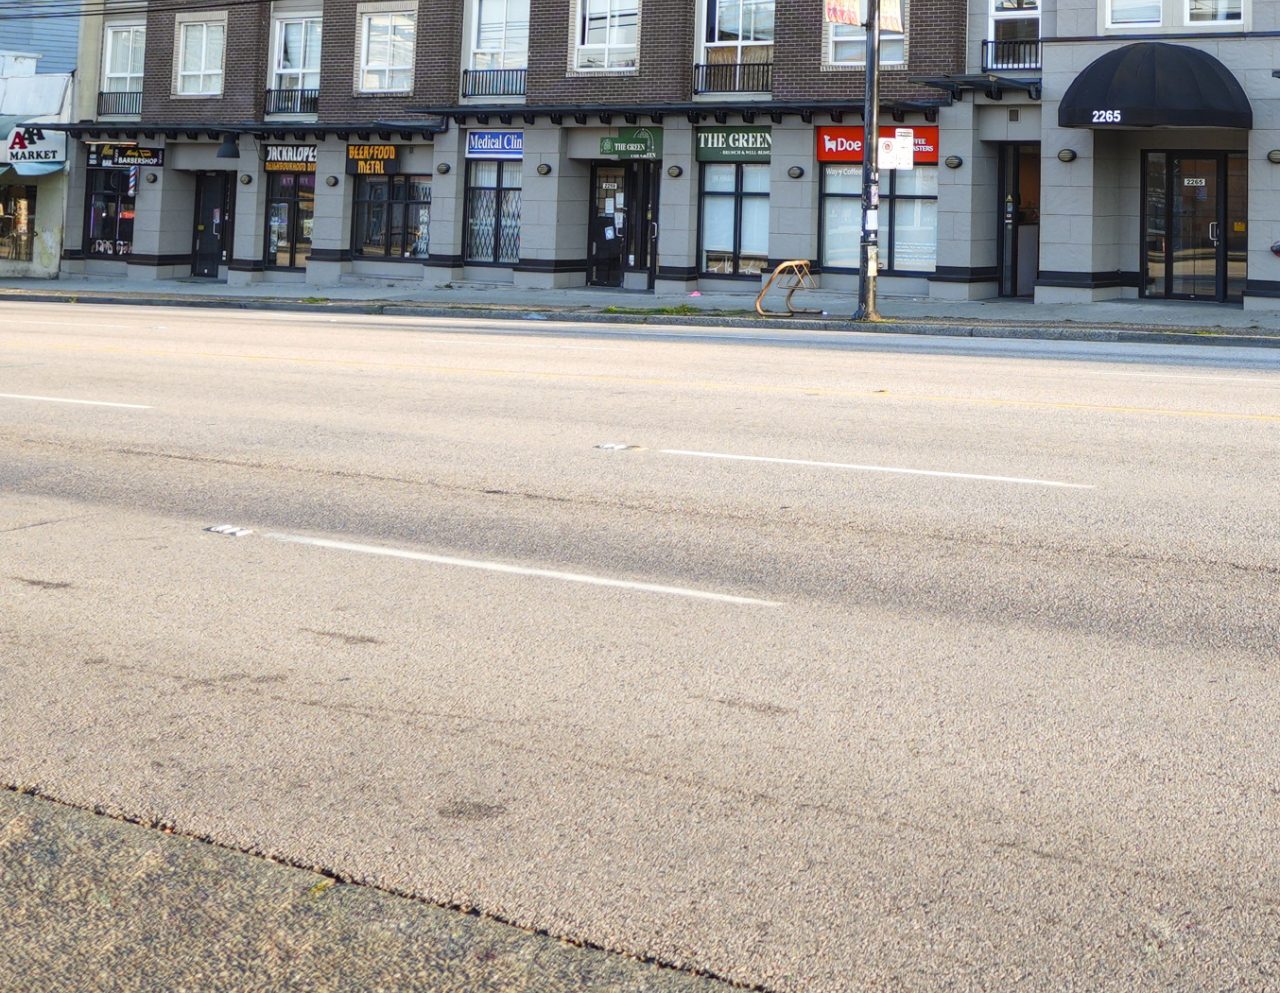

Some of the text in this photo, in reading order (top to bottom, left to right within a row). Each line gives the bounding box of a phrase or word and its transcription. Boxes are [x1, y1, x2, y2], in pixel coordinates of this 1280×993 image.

[1092, 110, 1121, 122] 2265
[470, 134, 502, 149] Medical
[698, 133, 726, 148] THE
[837, 138, 862, 151] Doe
[10, 150, 58, 161] MARKET
[118, 157, 158, 165] BARBERSHOP
[357, 160, 385, 174] METAL
